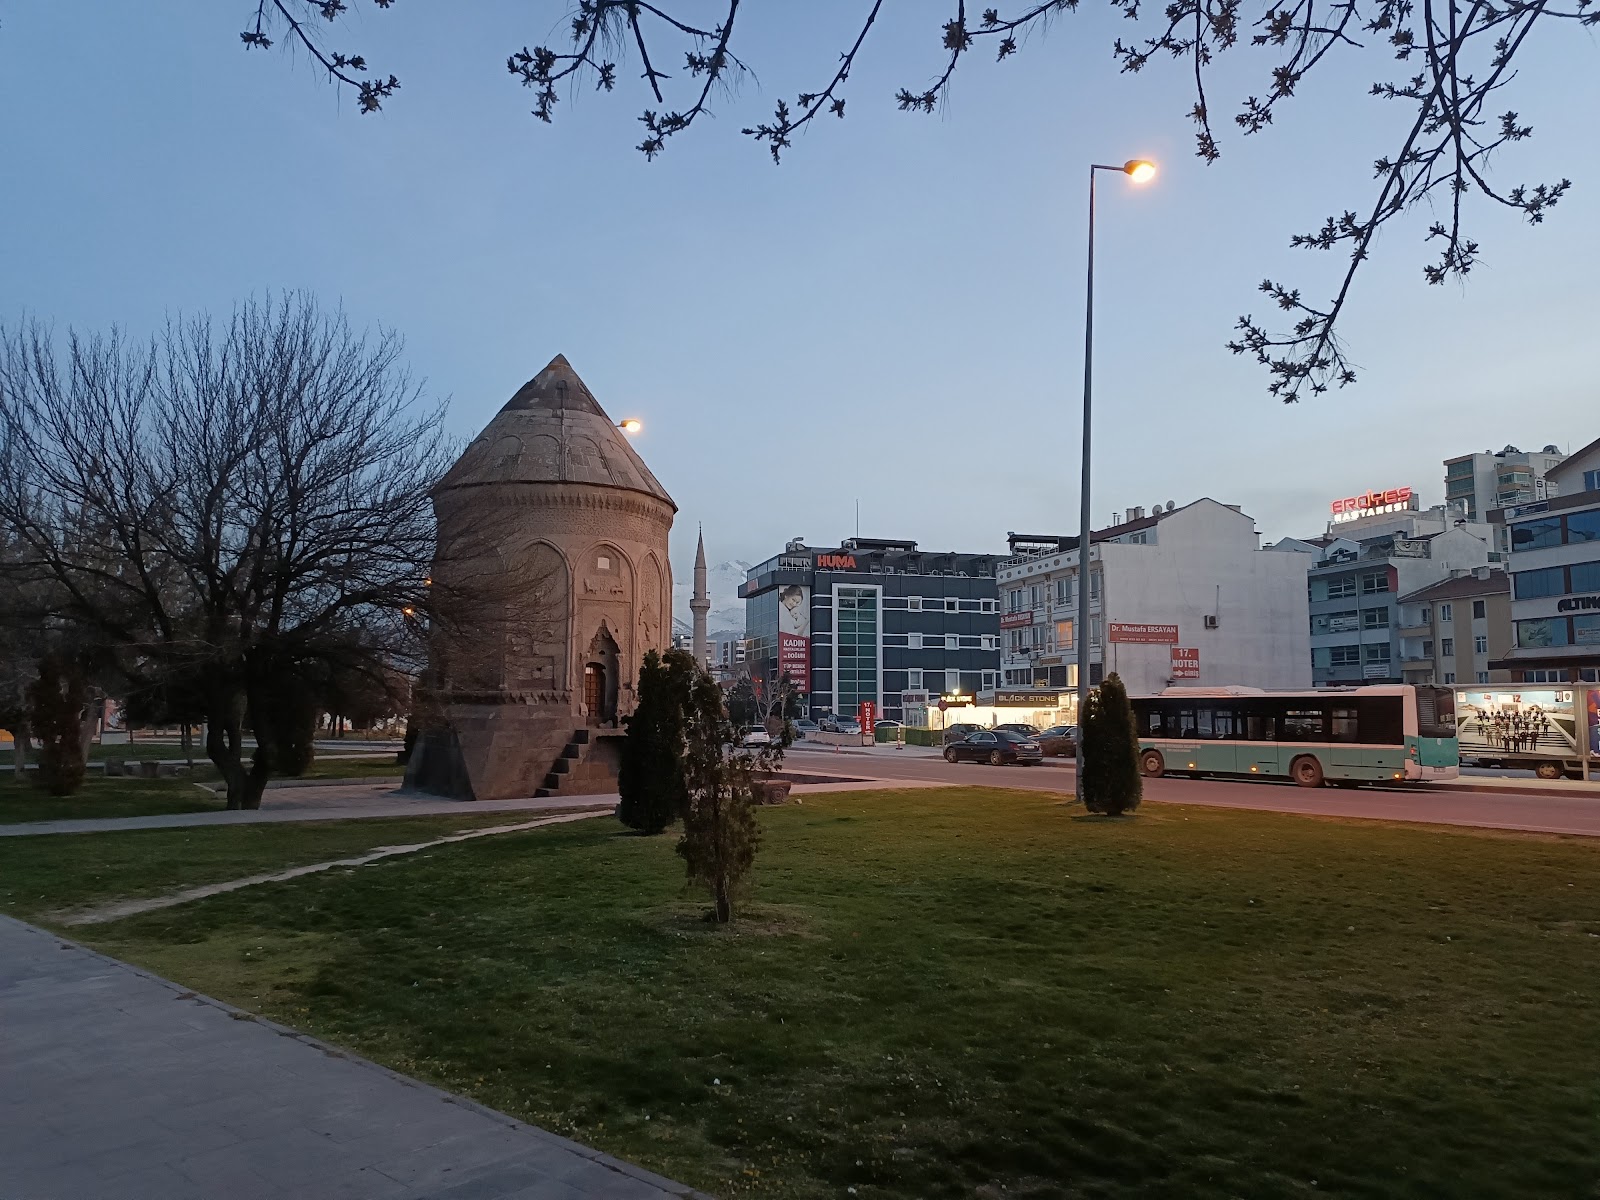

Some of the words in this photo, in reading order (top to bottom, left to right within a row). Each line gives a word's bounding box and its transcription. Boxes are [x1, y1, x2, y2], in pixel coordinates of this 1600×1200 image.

[817, 555, 857, 568] HUMA
[1179, 649, 1191, 657] 17.
[1173, 660, 1199, 668] NOTER
[998, 695, 1026, 704] BLACK
